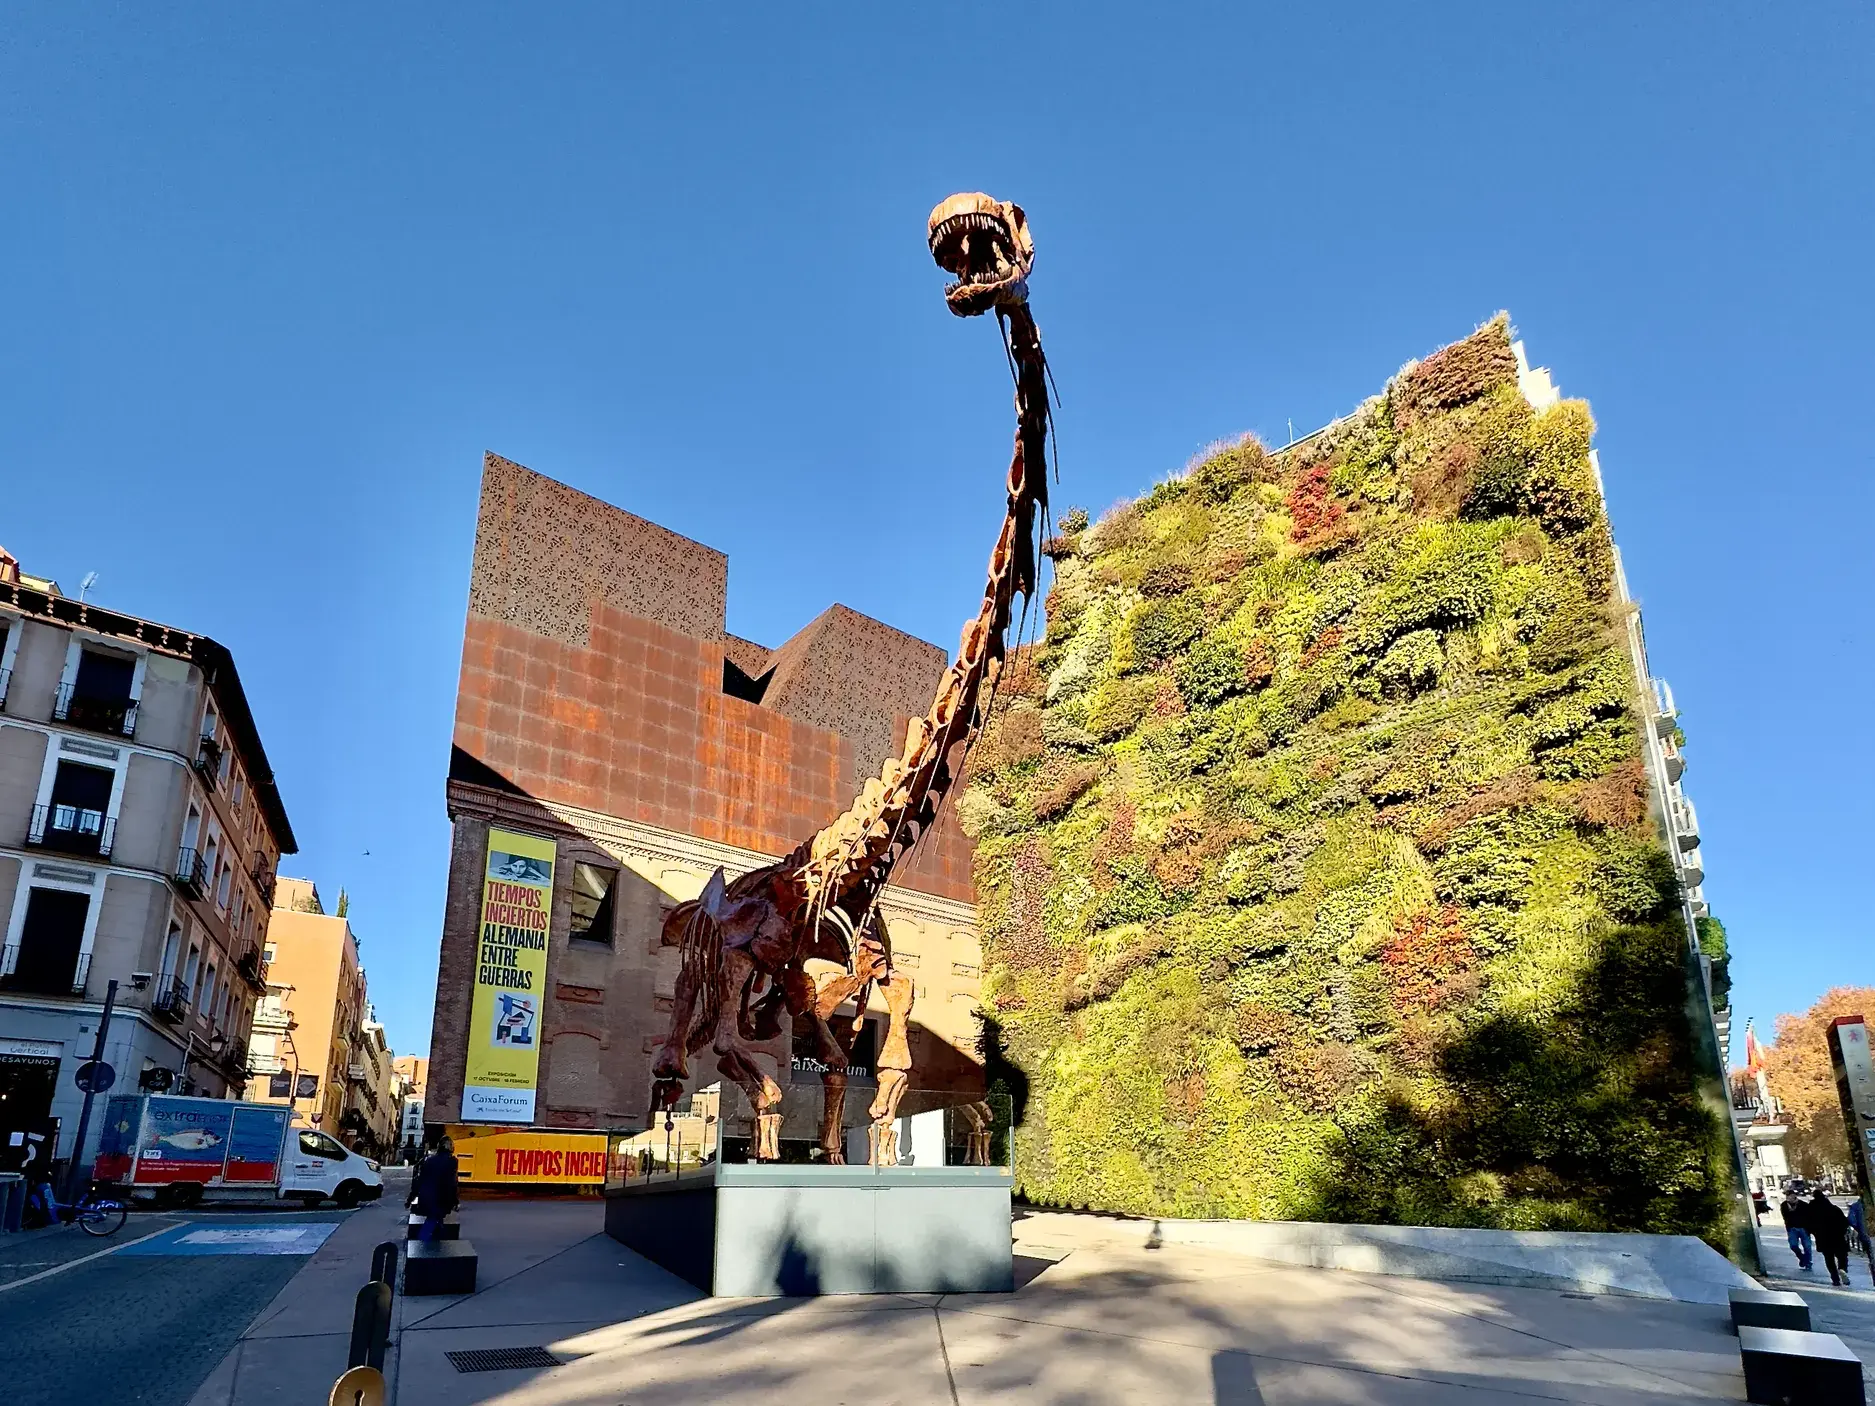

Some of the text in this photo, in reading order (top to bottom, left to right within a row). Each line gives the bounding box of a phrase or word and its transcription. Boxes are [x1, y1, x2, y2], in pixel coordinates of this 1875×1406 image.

[488, 881, 542, 908] TIEMPOS
[485, 902, 548, 930] INCIERTOS
[483, 923, 545, 951] ALEMANIA
[481, 944, 519, 967] ENTRE
[479, 965, 532, 990] GUERRAS
[0, 1056, 56, 1065] ESAYUNOS
[471, 1093, 528, 1105] CaixaForum
[495, 1149, 562, 1176] TIEMPOS
